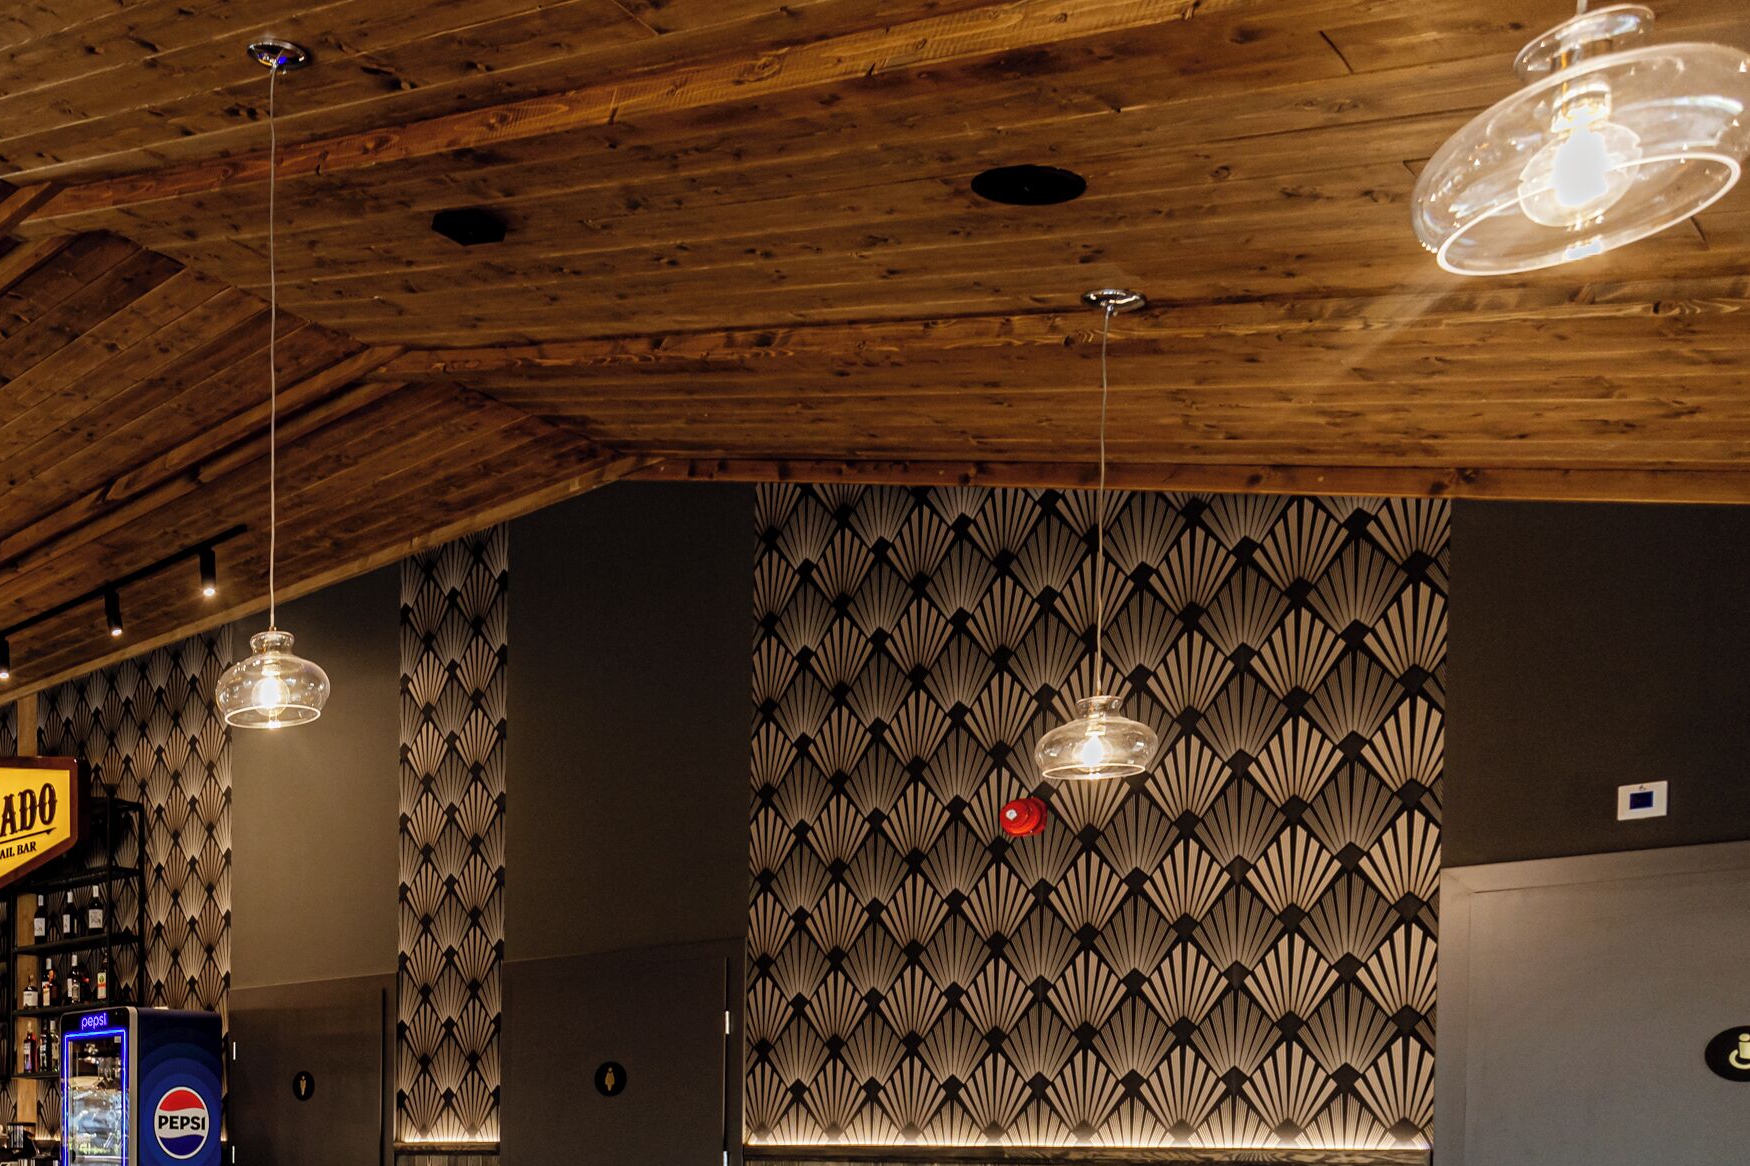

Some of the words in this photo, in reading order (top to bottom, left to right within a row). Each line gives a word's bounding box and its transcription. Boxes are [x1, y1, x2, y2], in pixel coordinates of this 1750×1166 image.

[17, 842, 36, 855] BAR
[81, 1012, 107, 1030] pepsi
[158, 1115, 206, 1131] PEPSI
